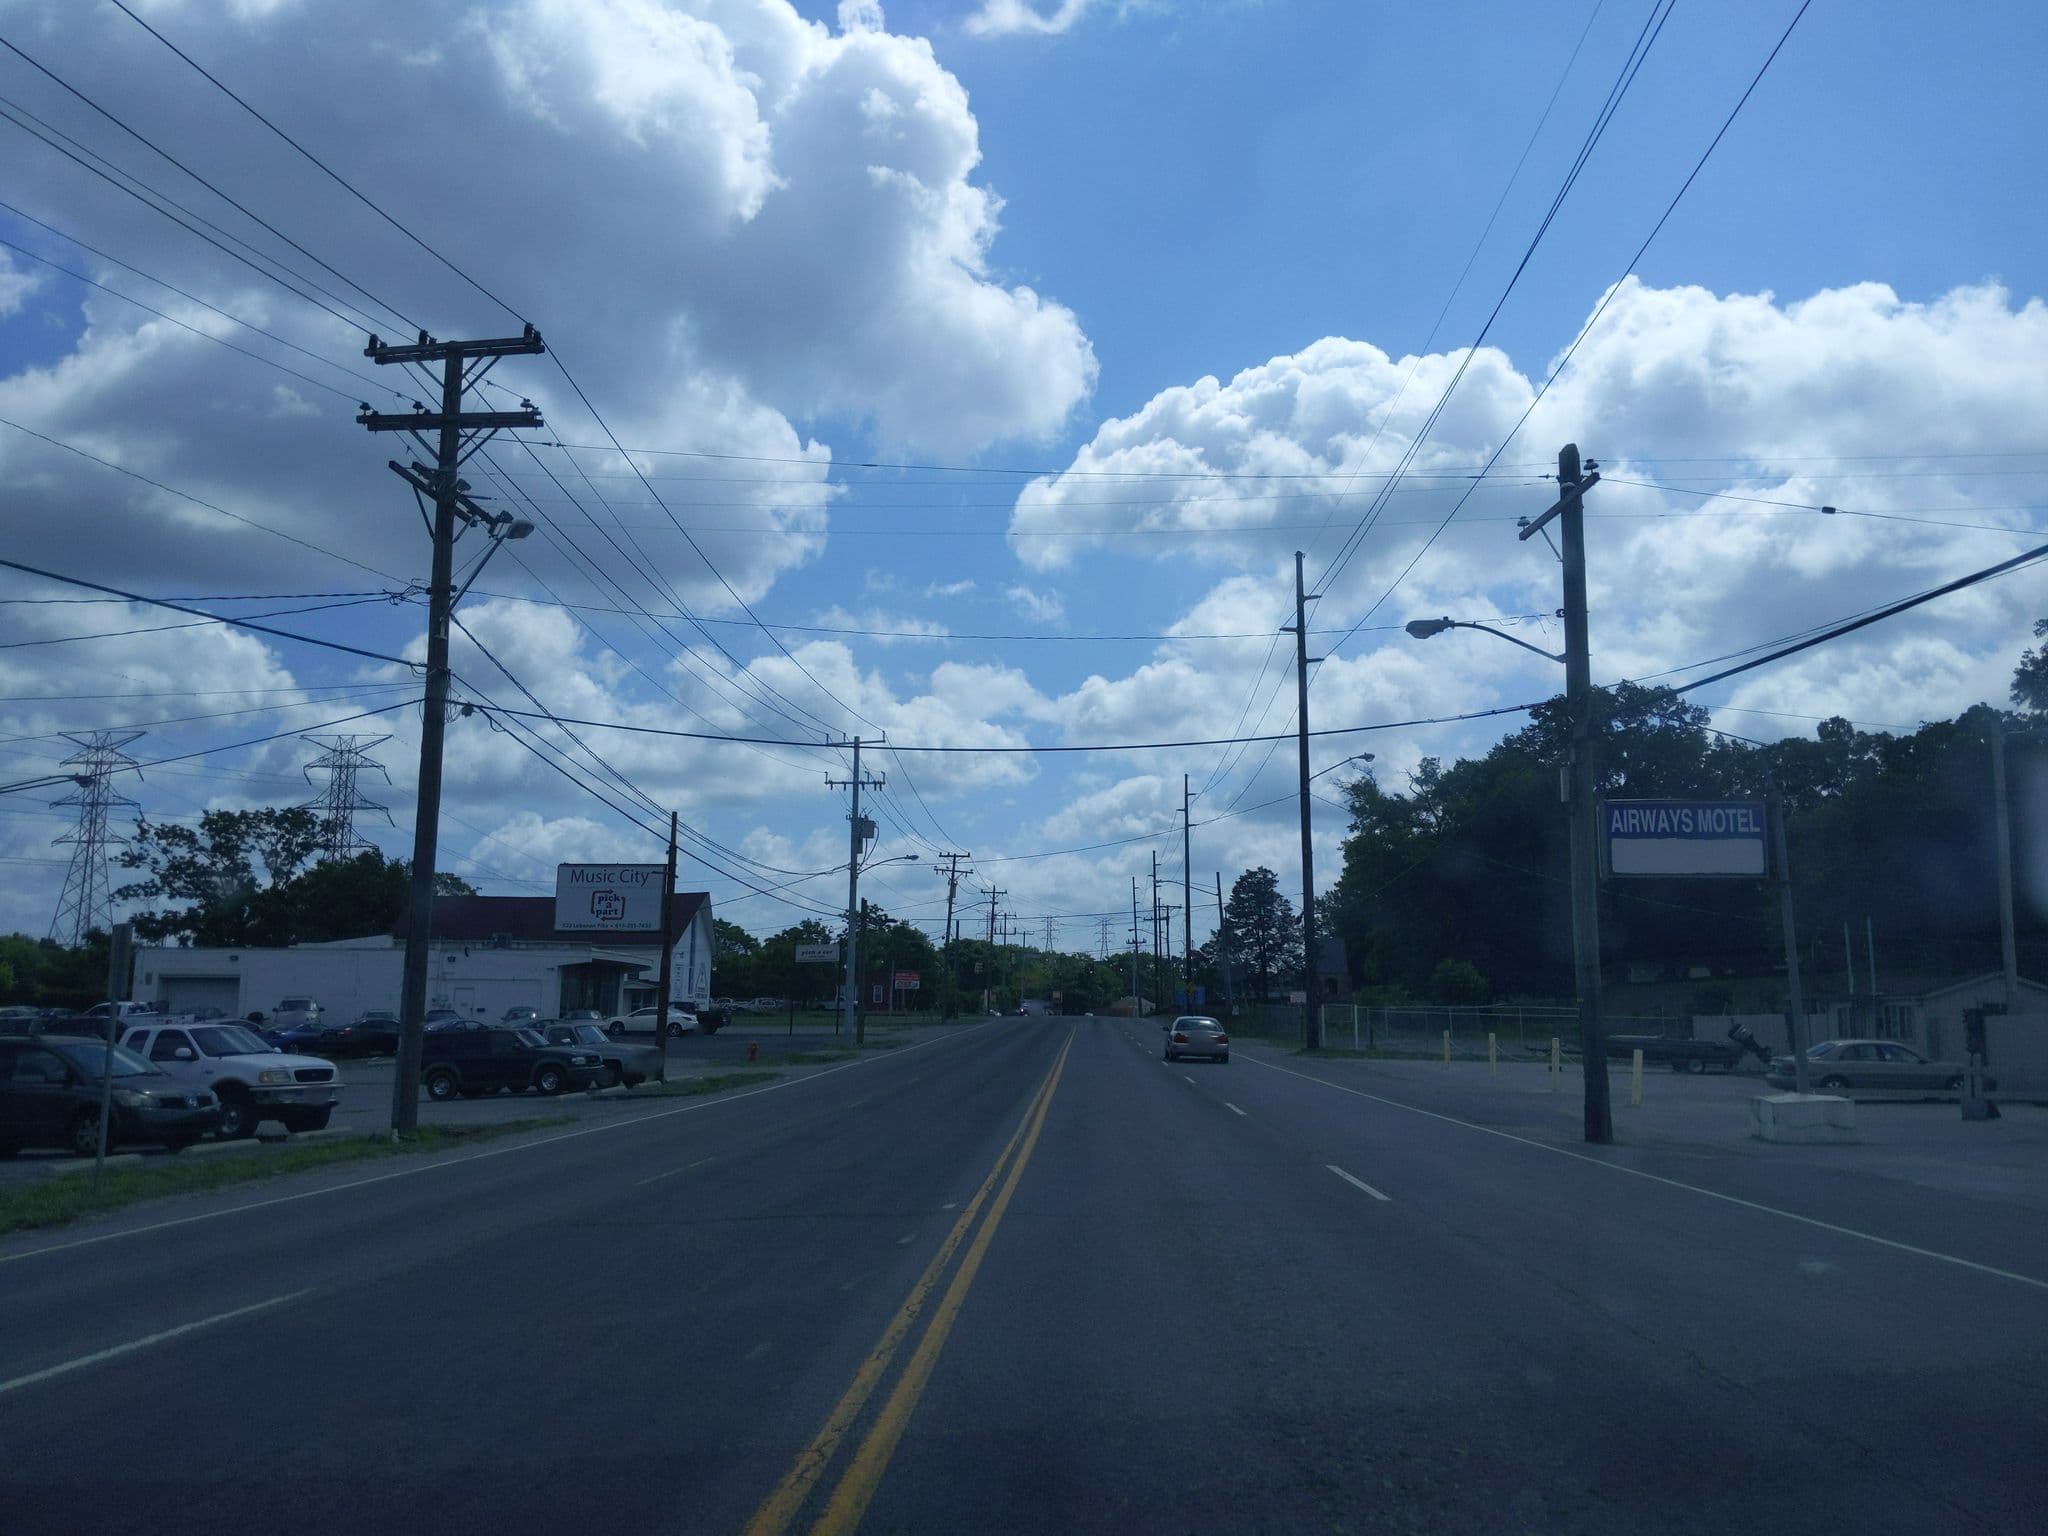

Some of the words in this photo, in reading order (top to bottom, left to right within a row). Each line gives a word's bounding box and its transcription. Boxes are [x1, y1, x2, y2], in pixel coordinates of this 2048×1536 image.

[1611, 808, 1693, 833] AIRWAYS
[1698, 808, 1760, 832] MOTEL
[571, 869, 615, 883] Music
[620, 869, 649, 887] City
[598, 894, 620, 904] pick
[596, 908, 618, 918] part
